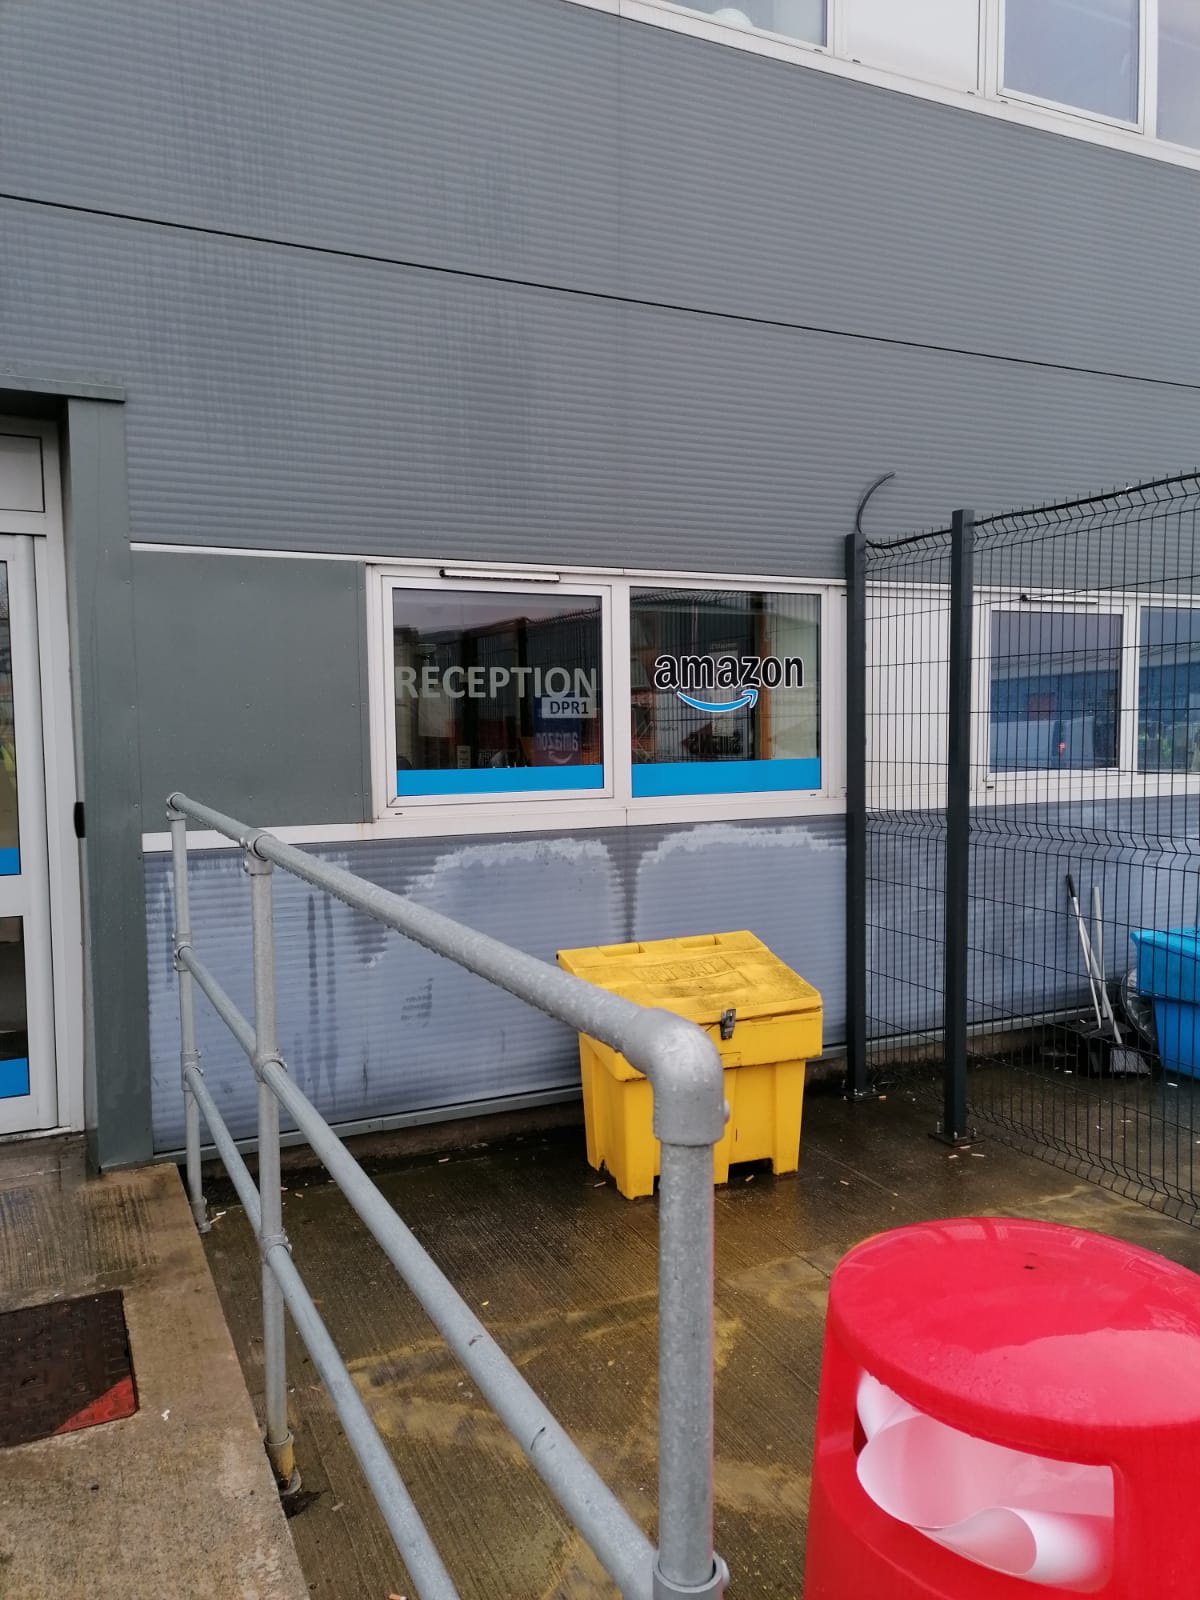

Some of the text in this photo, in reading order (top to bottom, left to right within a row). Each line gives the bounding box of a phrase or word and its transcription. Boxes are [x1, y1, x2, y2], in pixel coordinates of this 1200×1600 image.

[395, 666, 597, 699] RECEPTION
[654, 655, 804, 689] amazon
[550, 701, 589, 714] DPR1
